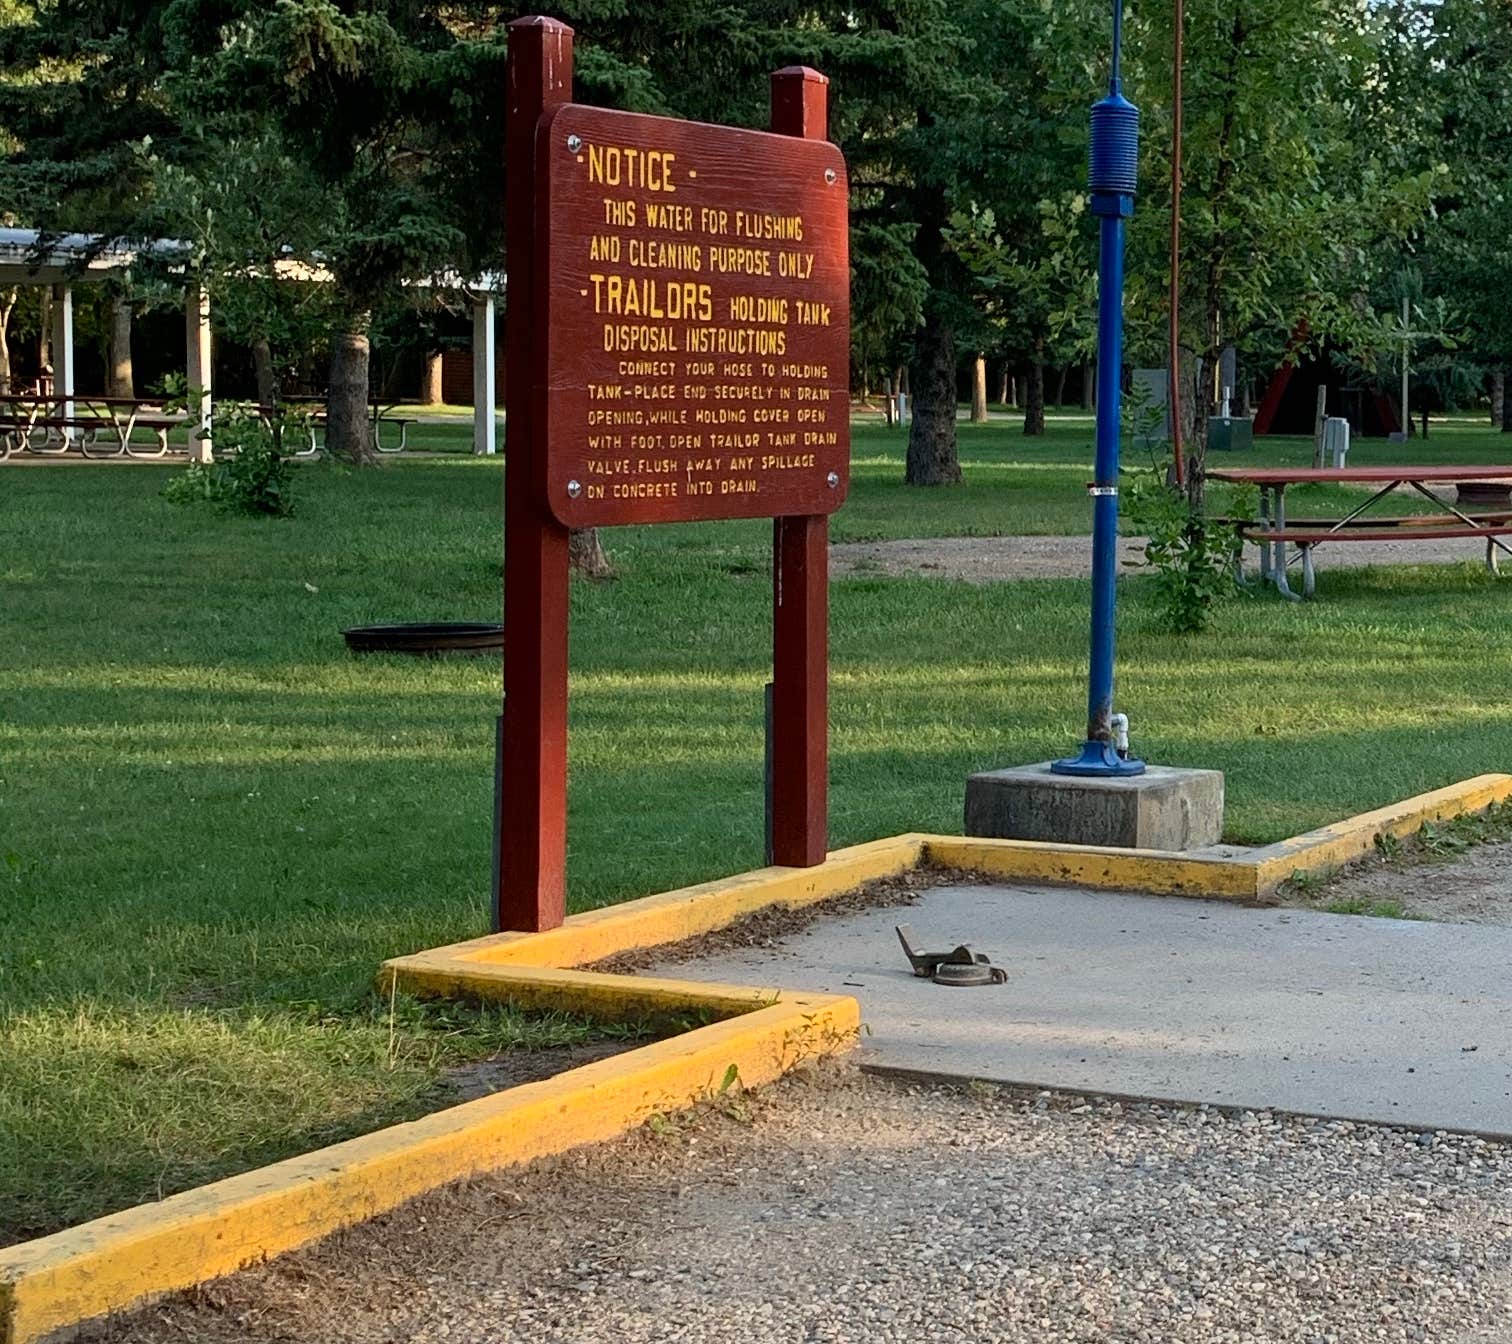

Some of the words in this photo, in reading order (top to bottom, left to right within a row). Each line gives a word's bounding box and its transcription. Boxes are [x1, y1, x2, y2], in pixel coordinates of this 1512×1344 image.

[588, 144, 676, 192] NOTICE
[603, 199, 636, 227] THIS
[646, 203, 693, 231] WATER
[702, 208, 728, 234] FOR
[736, 211, 803, 241] FLUSHING
[590, 235, 620, 262] AND
[629, 239, 701, 271] CLEANING
[710, 247, 771, 276] PURPOSE
[779, 251, 814, 279] ONLY
[590, 274, 712, 321] TRAILORS
[730, 296, 788, 324] HOLDING
[796, 301, 831, 326] TANK
[604, 324, 678, 352] DISPOSAL
[686, 327, 786, 355] INSTRUCTIONS
[619, 361, 676, 376] CONNECT
[685, 362, 715, 376] YOUR
[724, 363, 753, 377] HOSE
[762, 363, 775, 377] TO
[782, 364, 828, 378] HOLDING
[684, 385, 707, 399] END
[714, 385, 773, 400] SECURELY
[780, 387, 791, 399] IN
[797, 387, 830, 401] DRAIN
[695, 409, 747, 424] HOLDING
[753, 409, 790, 423] COVER
[797, 409, 827, 423] OPEN
[588, 436, 622, 449] WITH
[669, 434, 702, 448] OPEN
[710, 433, 760, 448] TRAILOR
[768, 433, 796, 446] TANK
[804, 432, 838, 446] DRAIN
[686, 458, 721, 471] AWAY
[730, 457, 754, 470] ANY
[761, 454, 816, 470] SPILLAGE
[587, 485, 605, 499] ON
[613, 482, 678, 497] CONCRETE
[686, 480, 713, 495] INTO
